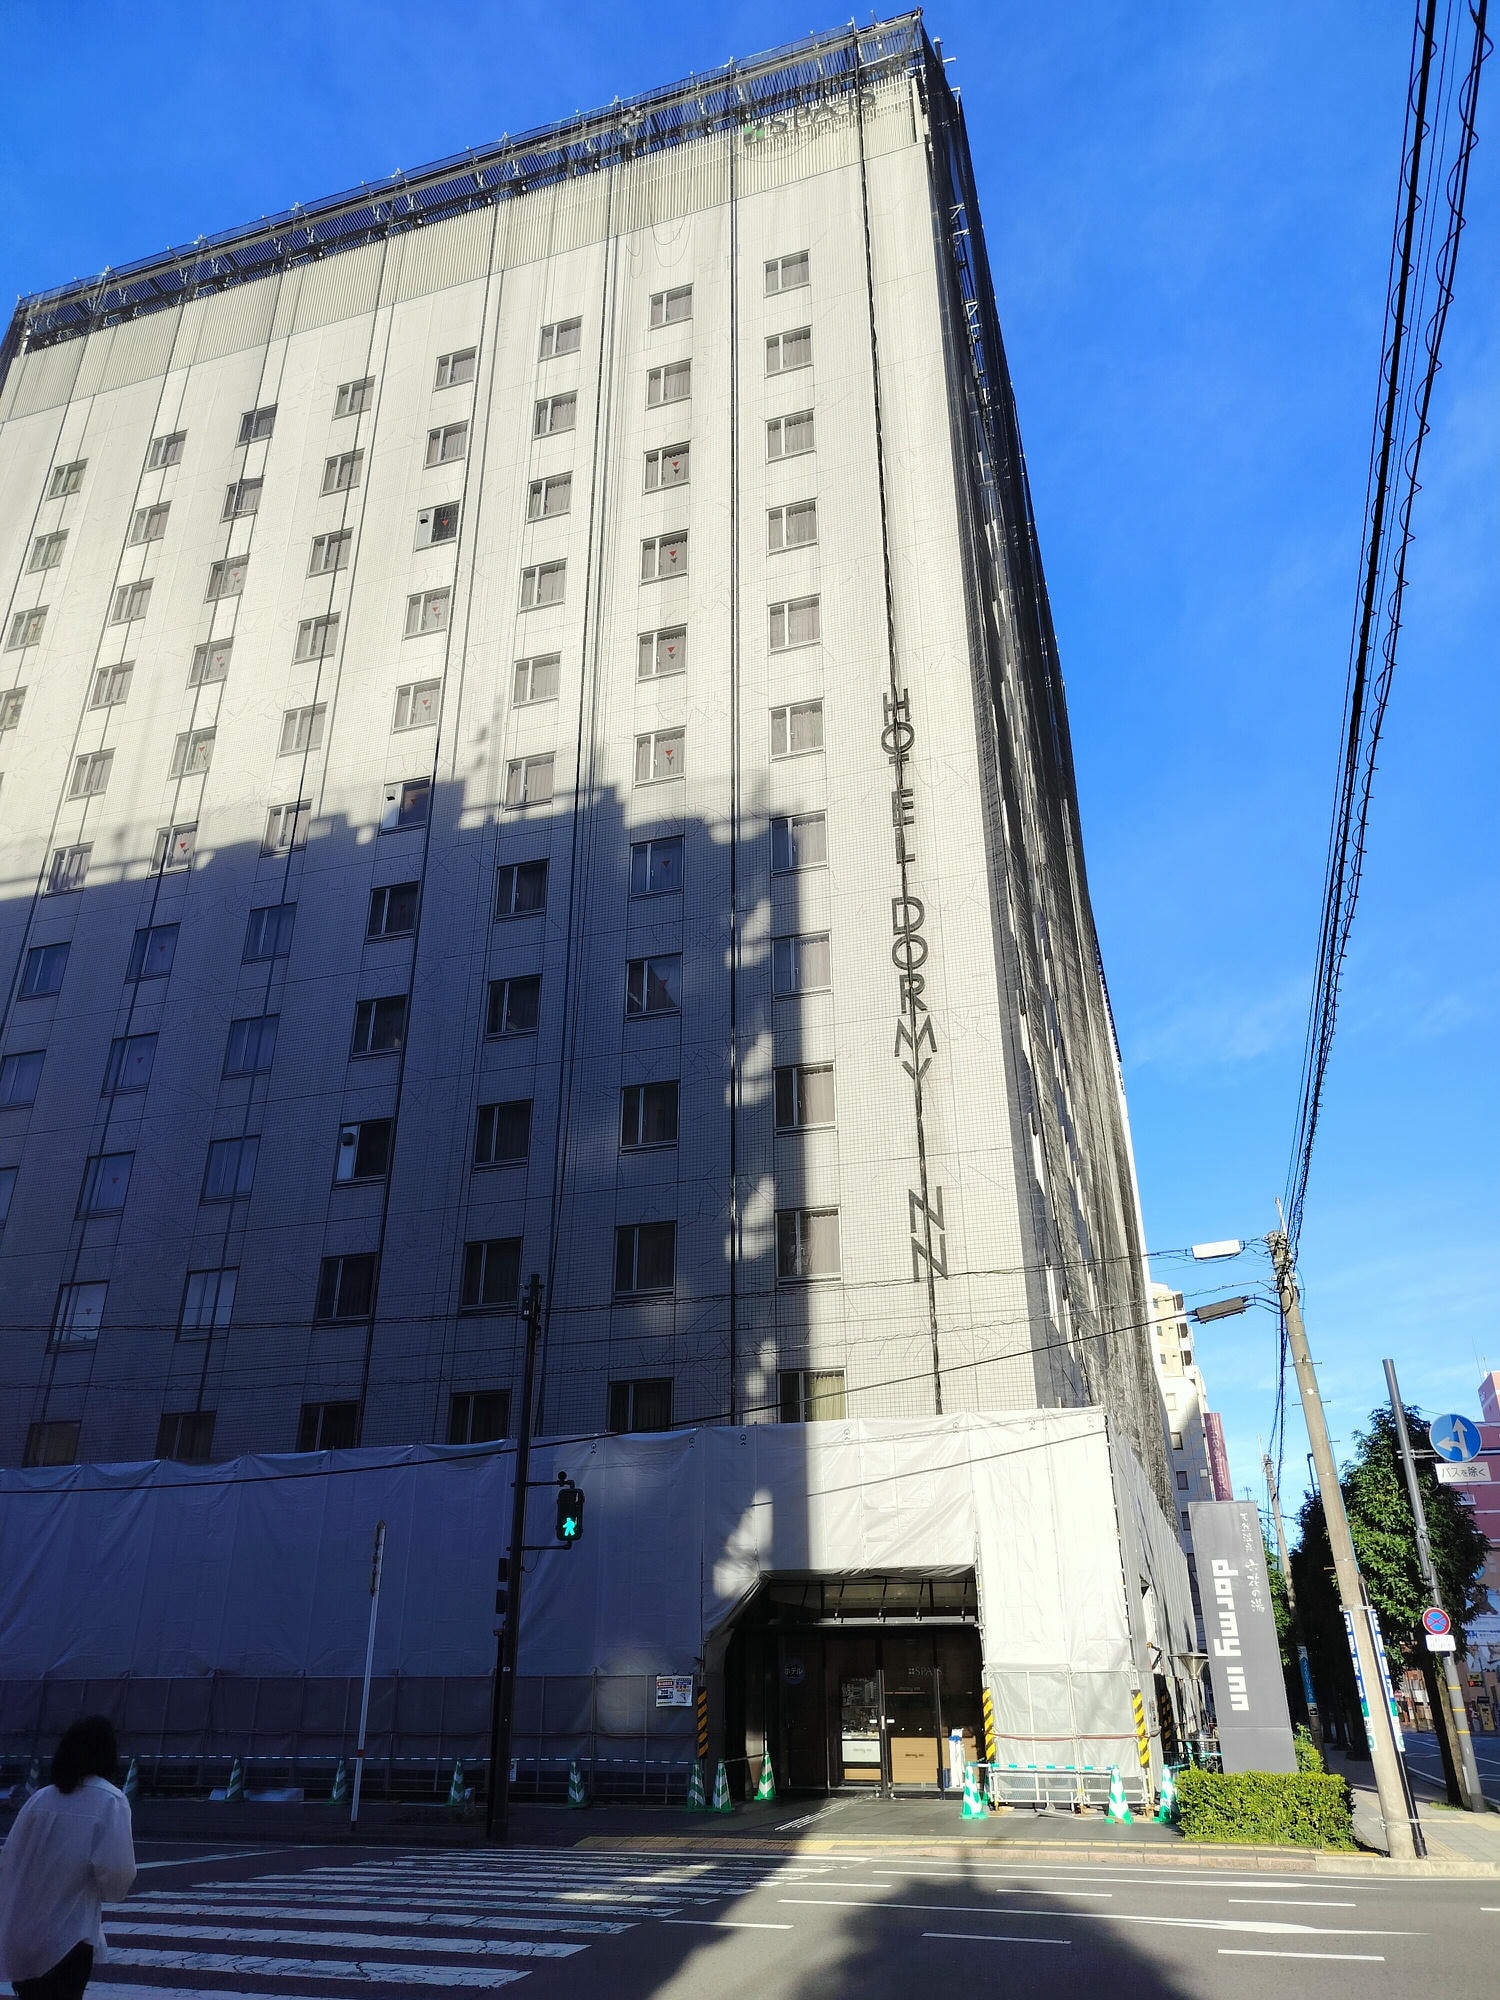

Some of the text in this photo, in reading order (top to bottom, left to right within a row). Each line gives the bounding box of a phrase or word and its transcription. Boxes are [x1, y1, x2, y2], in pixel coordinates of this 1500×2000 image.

[881, 688, 948, 1283] HOTEL DORMY NN
[1441, 1466, 1487, 1478] バスを除く
[1211, 1559, 1250, 1711] dormy inn
